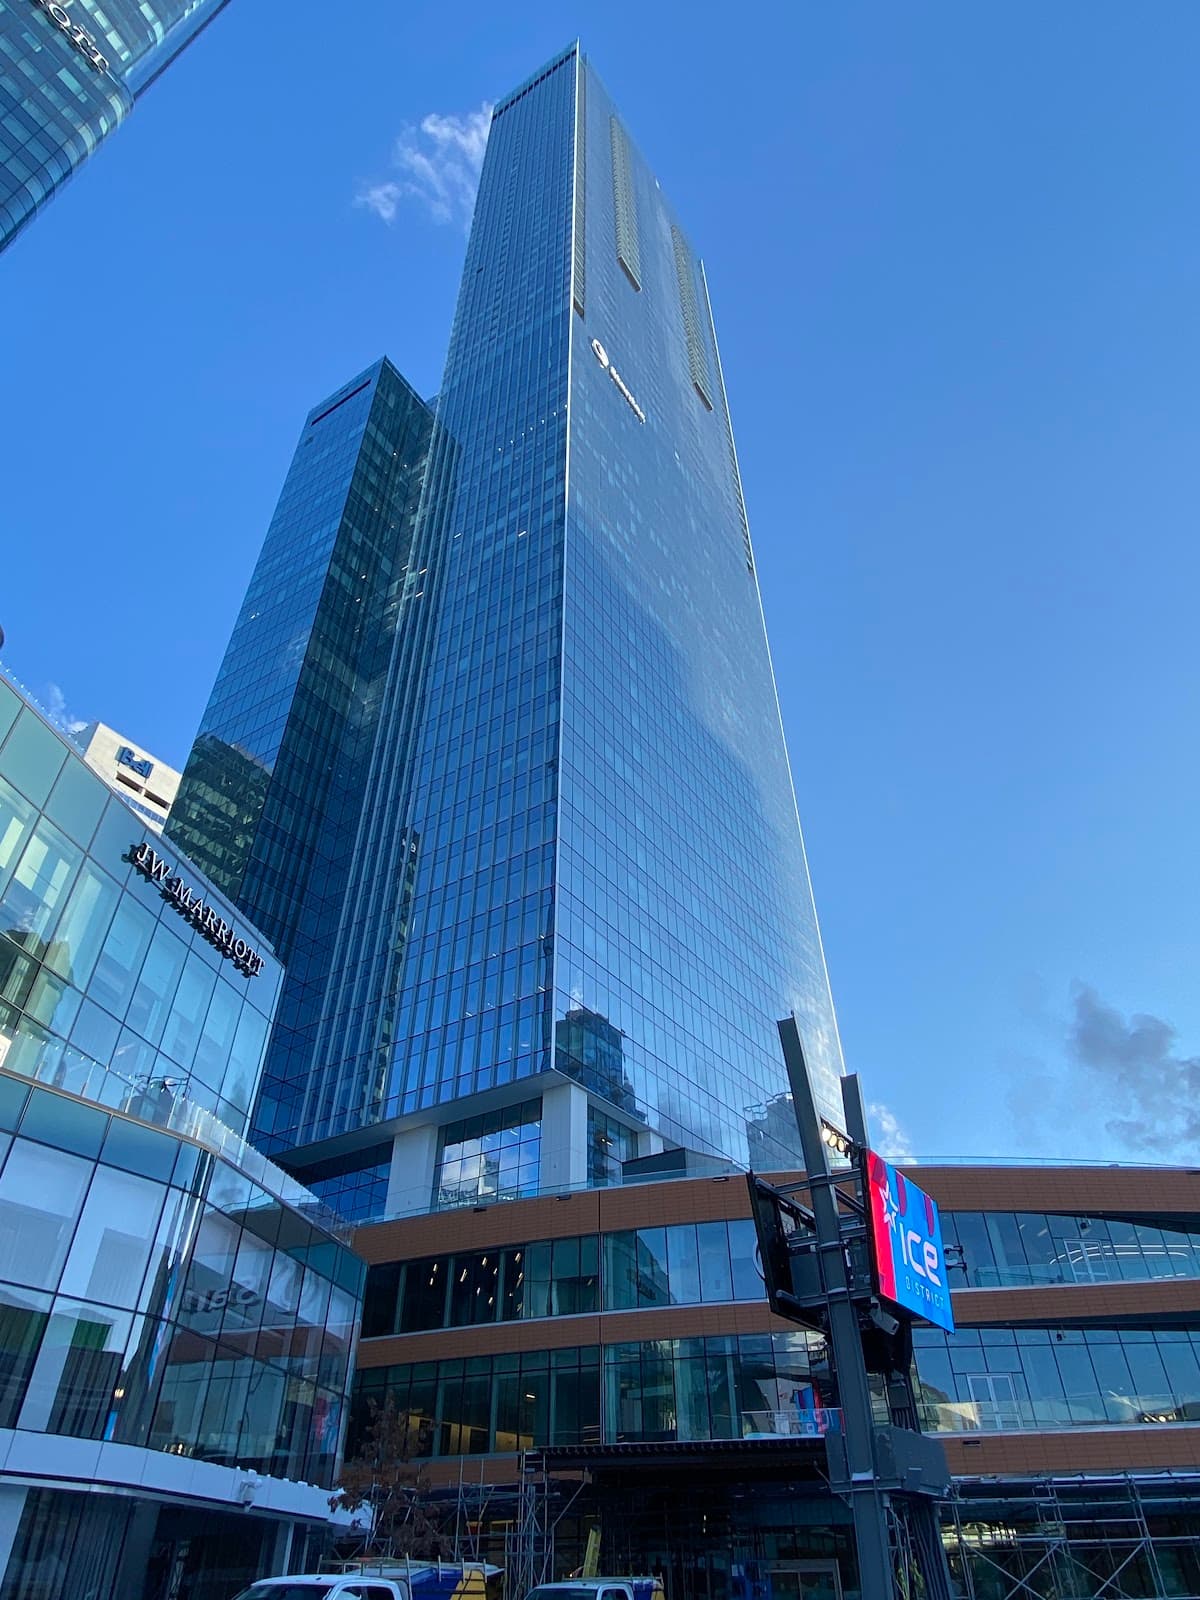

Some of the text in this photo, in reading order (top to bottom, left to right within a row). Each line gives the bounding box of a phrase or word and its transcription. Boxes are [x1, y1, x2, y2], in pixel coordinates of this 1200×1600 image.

[40, 0, 109, 73] OTT
[119, 746, 154, 779] Bell
[136, 842, 266, 977] JW MARRIOTT
[905, 1275, 944, 1308] DISTRICT
